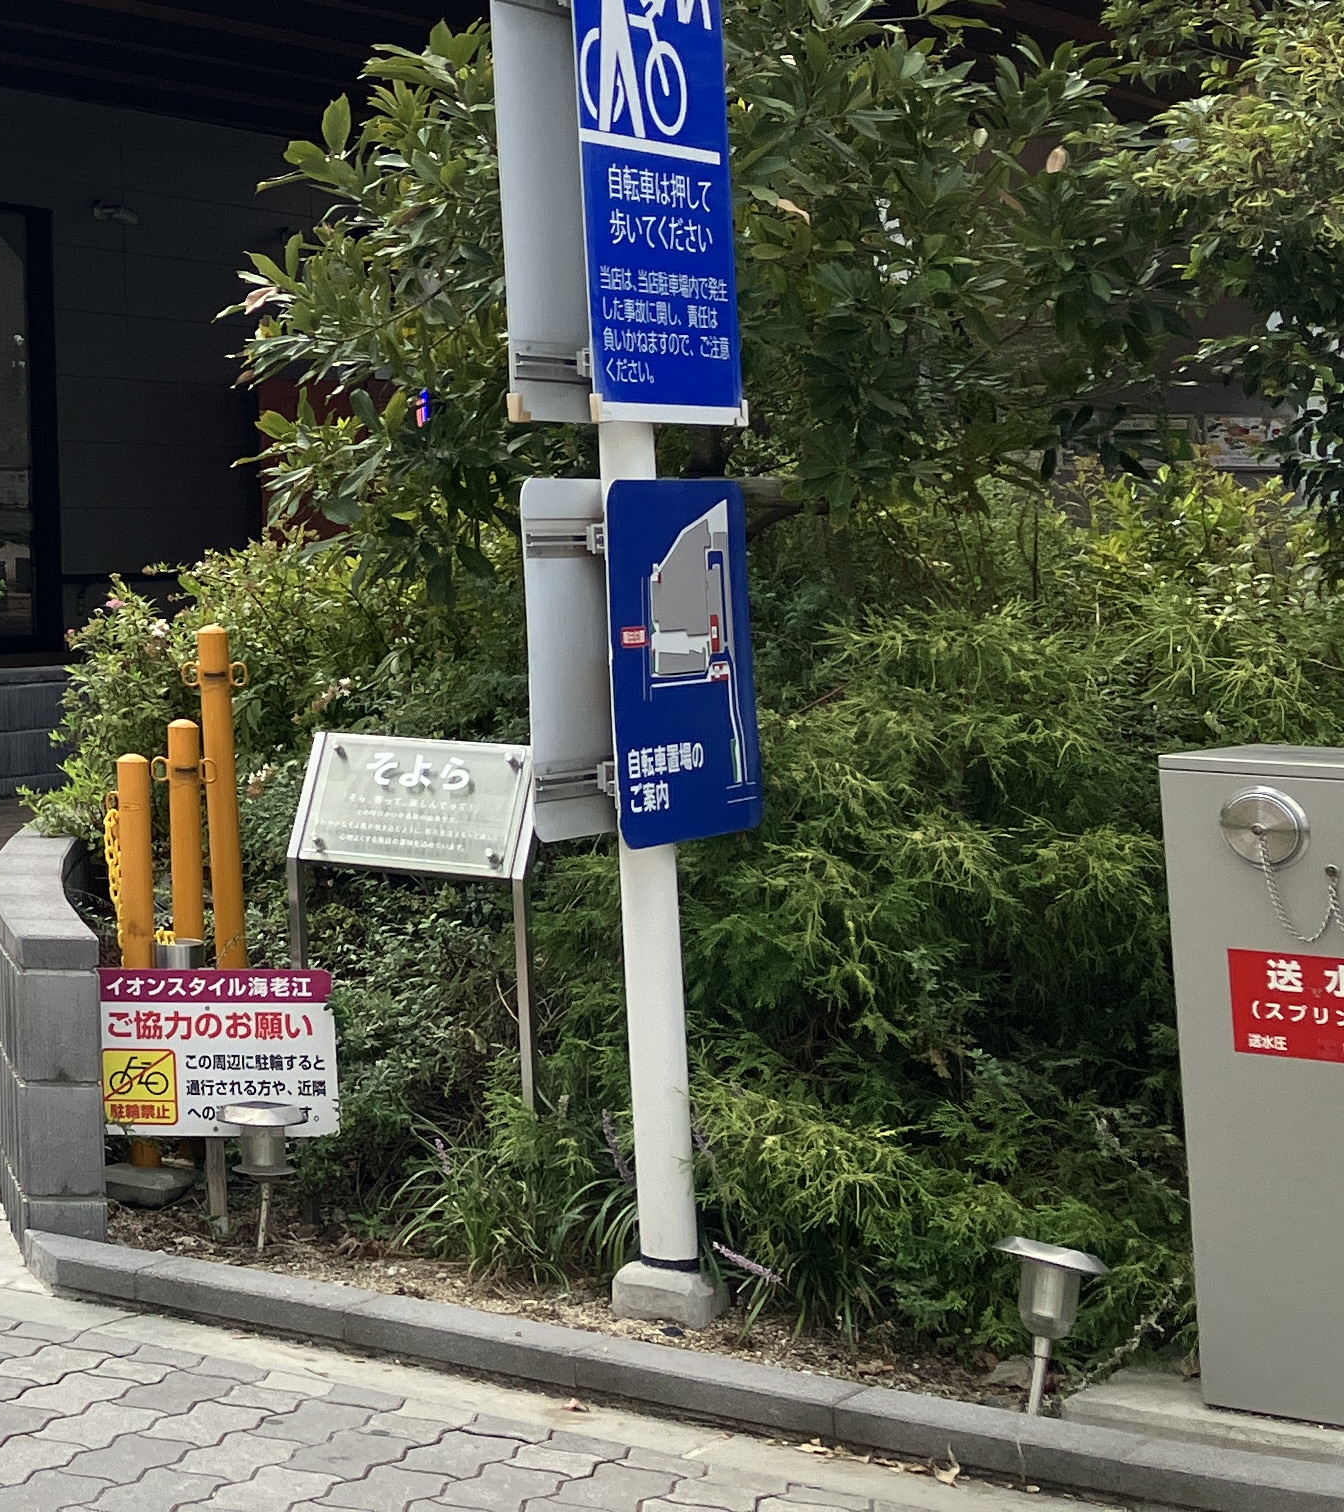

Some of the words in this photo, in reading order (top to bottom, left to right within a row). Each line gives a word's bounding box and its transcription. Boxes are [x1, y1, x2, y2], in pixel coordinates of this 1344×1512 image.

[608, 163, 712, 213] 自転車は押して
[609, 208, 714, 253] 歩いてください
[606, 357, 655, 384] ください。
[366, 752, 470, 791] そよら
[628, 742, 704, 779] 自転車置場の
[630, 780, 670, 813] ご案内
[106, 977, 313, 998] イオンスタイル海老江
[108, 1010, 313, 1040] ご協力のお願い
[185, 1054, 326, 1071] この周辺に駐輪すると
[186, 1080, 327, 1097] 通行される方や、近隣
[110, 1104, 171, 1120] 駐輪禁止
